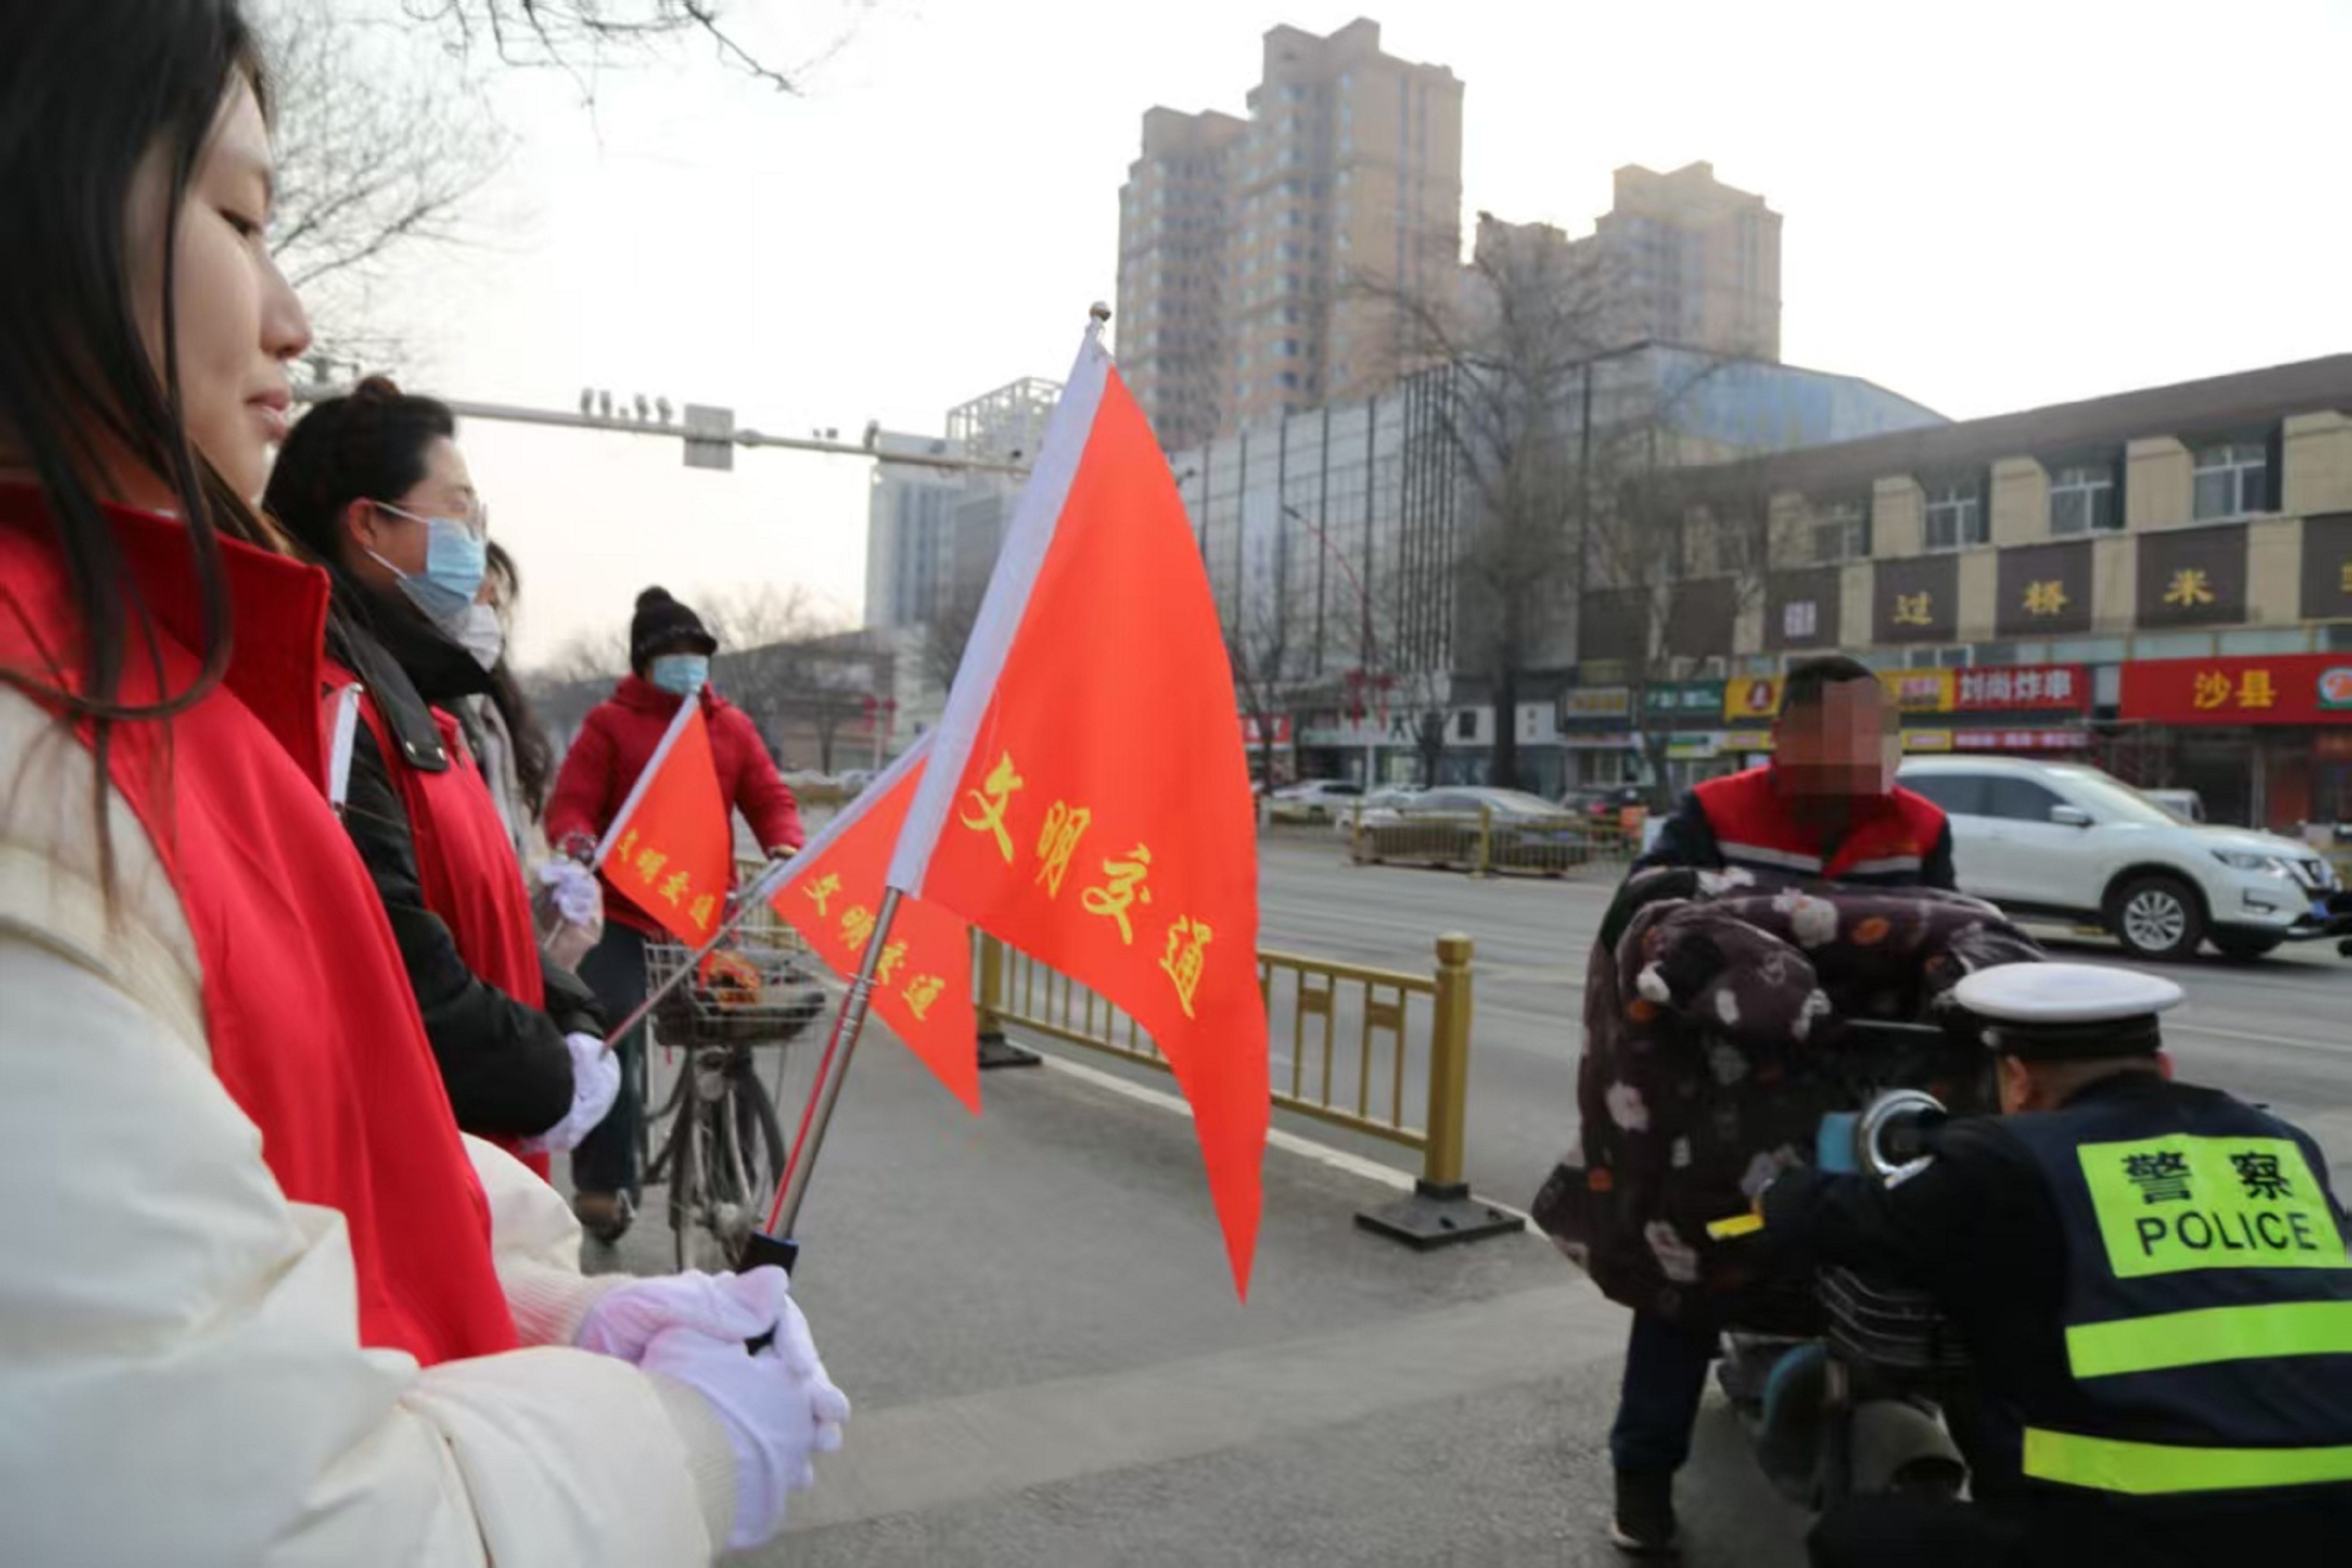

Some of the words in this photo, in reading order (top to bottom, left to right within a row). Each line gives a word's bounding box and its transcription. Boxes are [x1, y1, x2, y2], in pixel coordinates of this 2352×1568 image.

[1892, 565, 2352, 627] 过桥米
[2193, 667, 2277, 709] 沙县
[960, 750, 1212, 1019] 文明交通
[2121, 1150, 2294, 1205] 警察
[2135, 1210, 2318, 1257] POLICE
